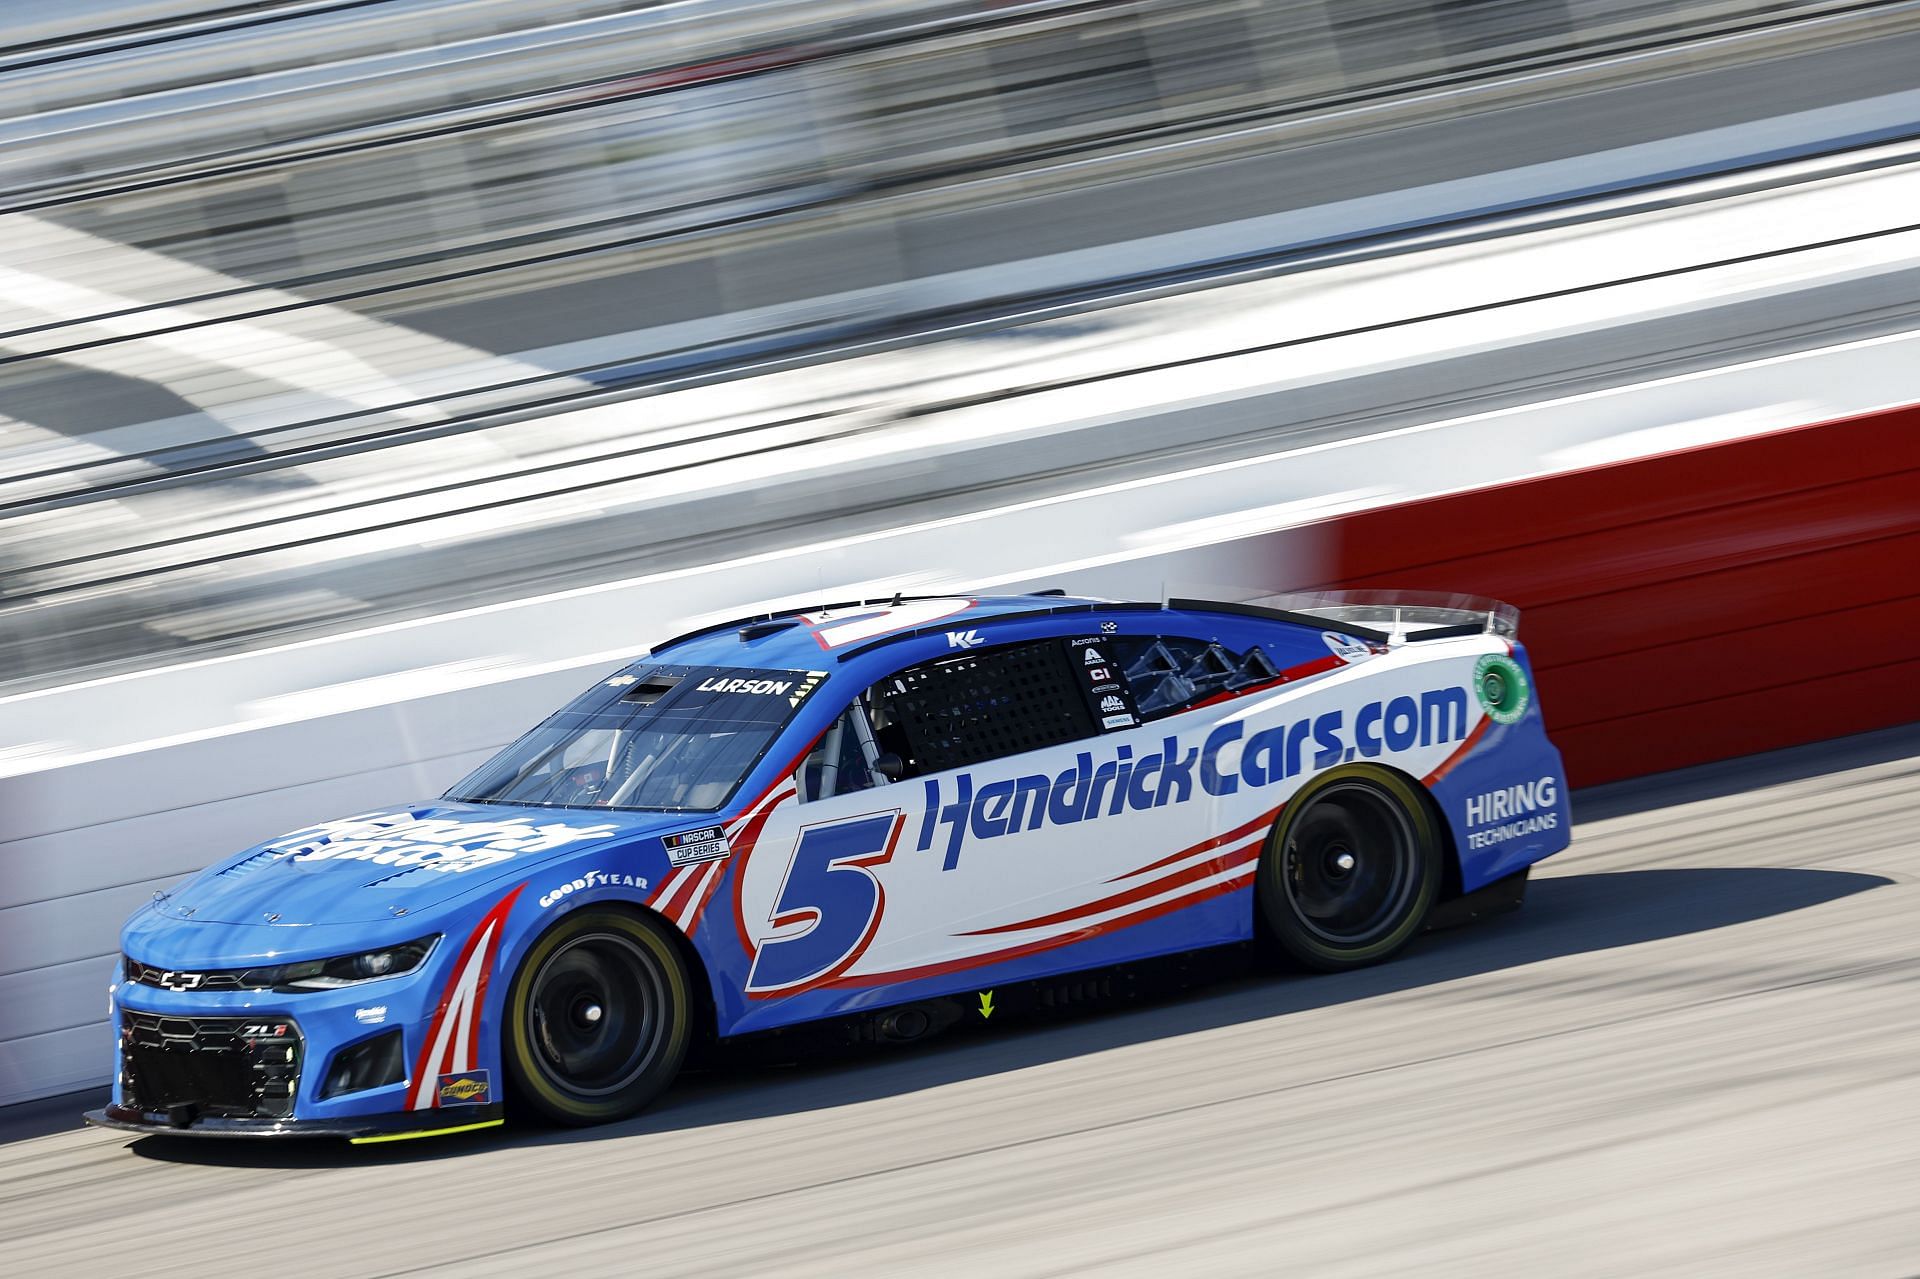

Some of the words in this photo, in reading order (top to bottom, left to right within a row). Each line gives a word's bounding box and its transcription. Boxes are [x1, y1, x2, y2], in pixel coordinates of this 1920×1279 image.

[1072, 638, 1100, 647] Acronis
[696, 678, 792, 695] LARSON
[1101, 696, 1125, 709] MAC
[917, 685, 1467, 871] HendrickCars.com
[1466, 777, 1557, 827] HIRING
[682, 829, 715, 844] NASCAR
[1467, 813, 1557, 850] TECHNICIANS
[677, 849, 693, 859] CUP
[694, 842, 720, 856] SERIES
[745, 808, 907, 1000] 5
